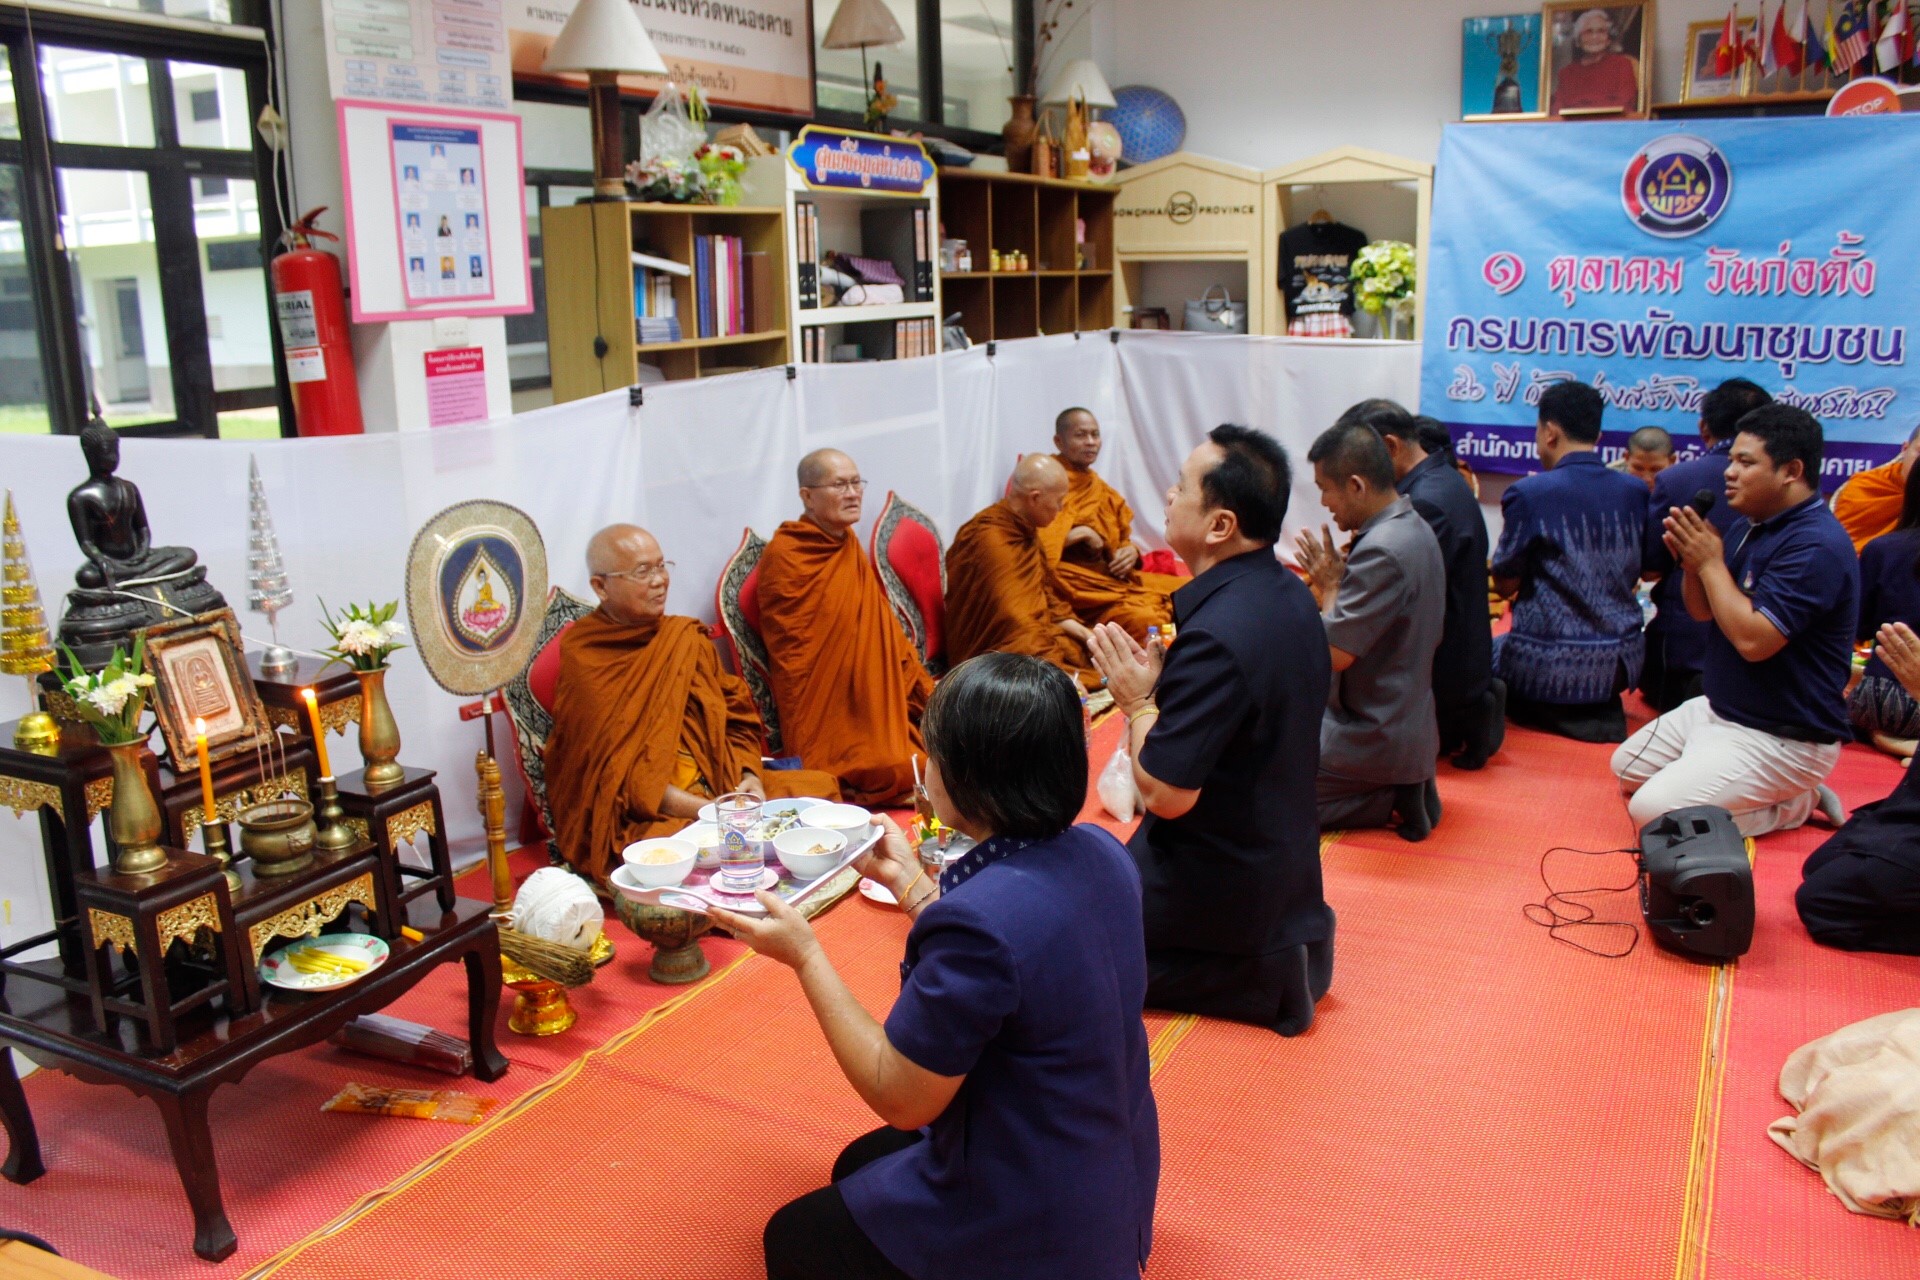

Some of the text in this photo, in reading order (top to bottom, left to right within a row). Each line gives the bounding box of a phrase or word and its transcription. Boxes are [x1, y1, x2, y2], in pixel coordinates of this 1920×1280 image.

[1199, 205, 1255, 215] PROVINCE
[1483, 232, 1876, 306] ๑ ตุลาคม วันก่อตั้ง
[1448, 309, 1904, 375] กรมการพัฒนาชุมชน
[1493, 361, 1521, 402] ปี
